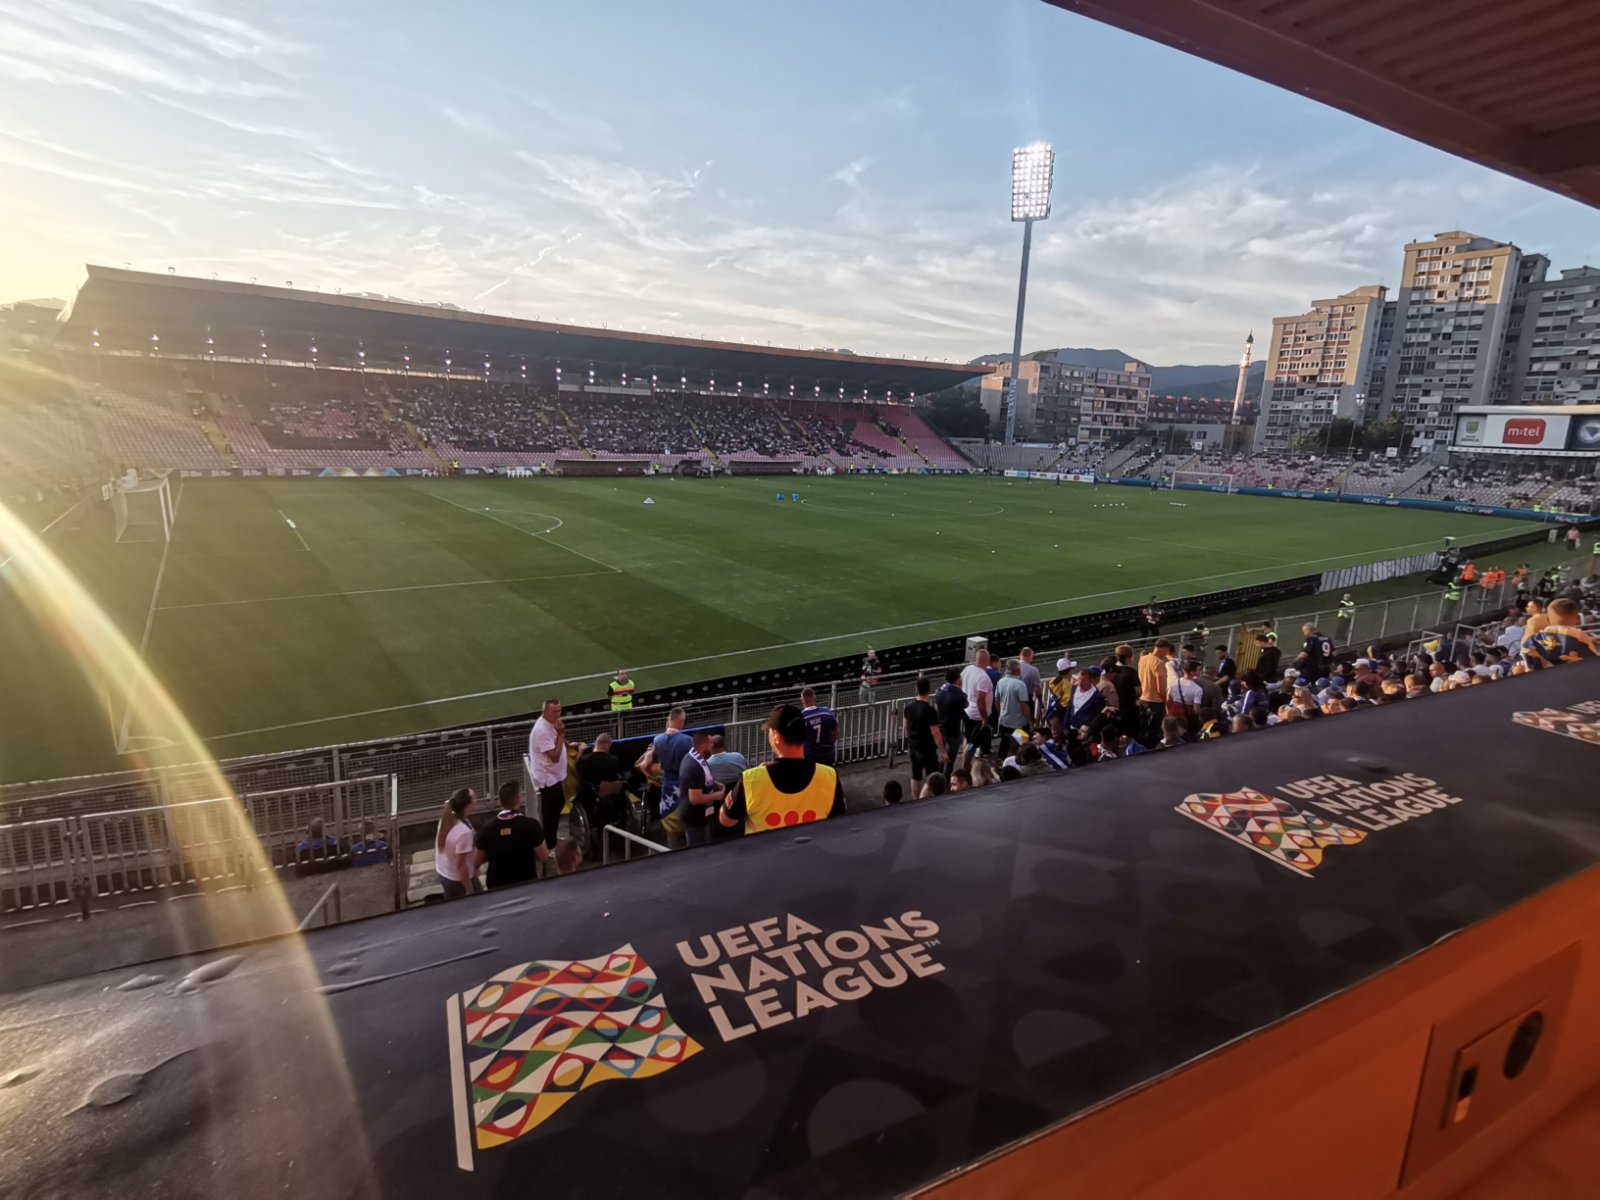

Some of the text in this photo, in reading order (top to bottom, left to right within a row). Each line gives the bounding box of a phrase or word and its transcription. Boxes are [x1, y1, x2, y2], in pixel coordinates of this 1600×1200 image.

[1507, 426, 1540, 437] m:tel
[1322, 641, 1331, 657] 9
[812, 724, 821, 743] 7
[1275, 774, 1362, 799] UEFA
[1309, 772, 1437, 815] NATIONS
[1345, 787, 1464, 831] LEAGUE
[676, 913, 822, 967] UEFA
[691, 911, 939, 1003] NATIONS
[708, 944, 946, 1042] LEAGUE
